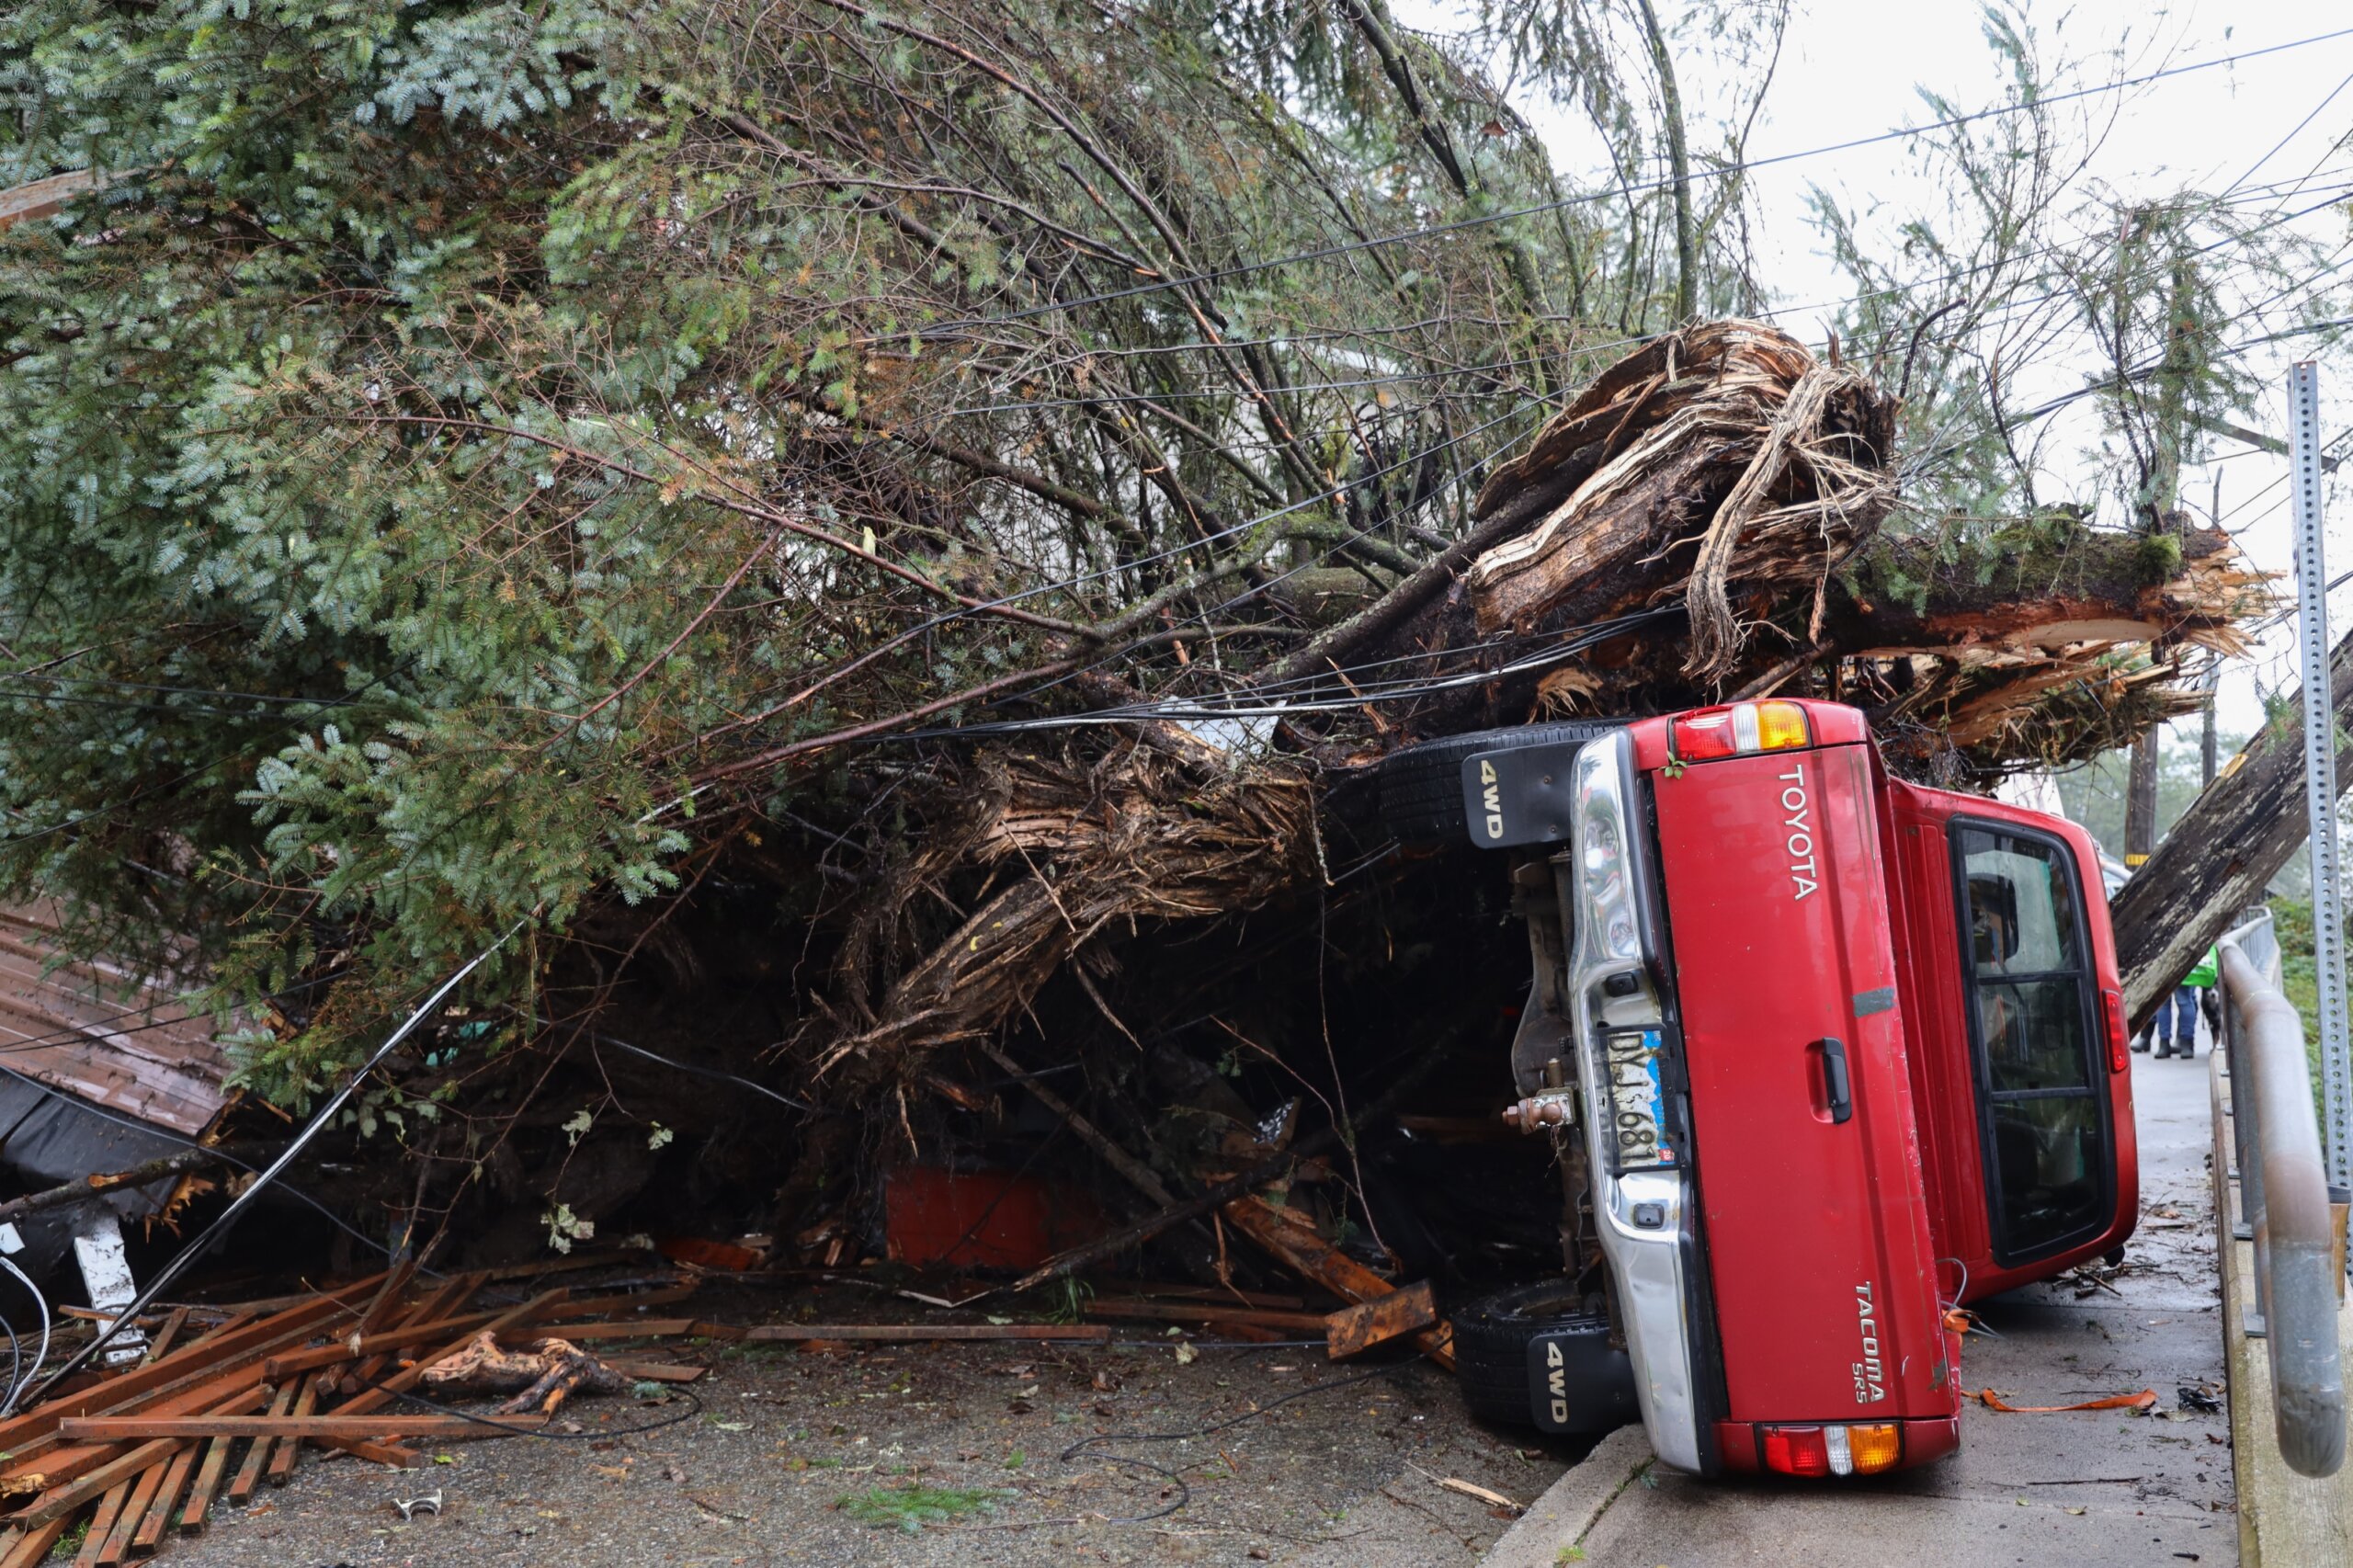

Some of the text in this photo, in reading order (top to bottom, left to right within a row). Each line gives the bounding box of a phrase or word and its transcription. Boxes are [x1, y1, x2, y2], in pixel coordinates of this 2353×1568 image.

[1481, 760, 1503, 838] 4WD
[1779, 764, 1818, 900] TOYOTA
[1609, 1034, 1655, 1160] DYJ 681
[1547, 1342, 1568, 1424] 4WD
[1856, 1281, 1884, 1402] TACOMA
